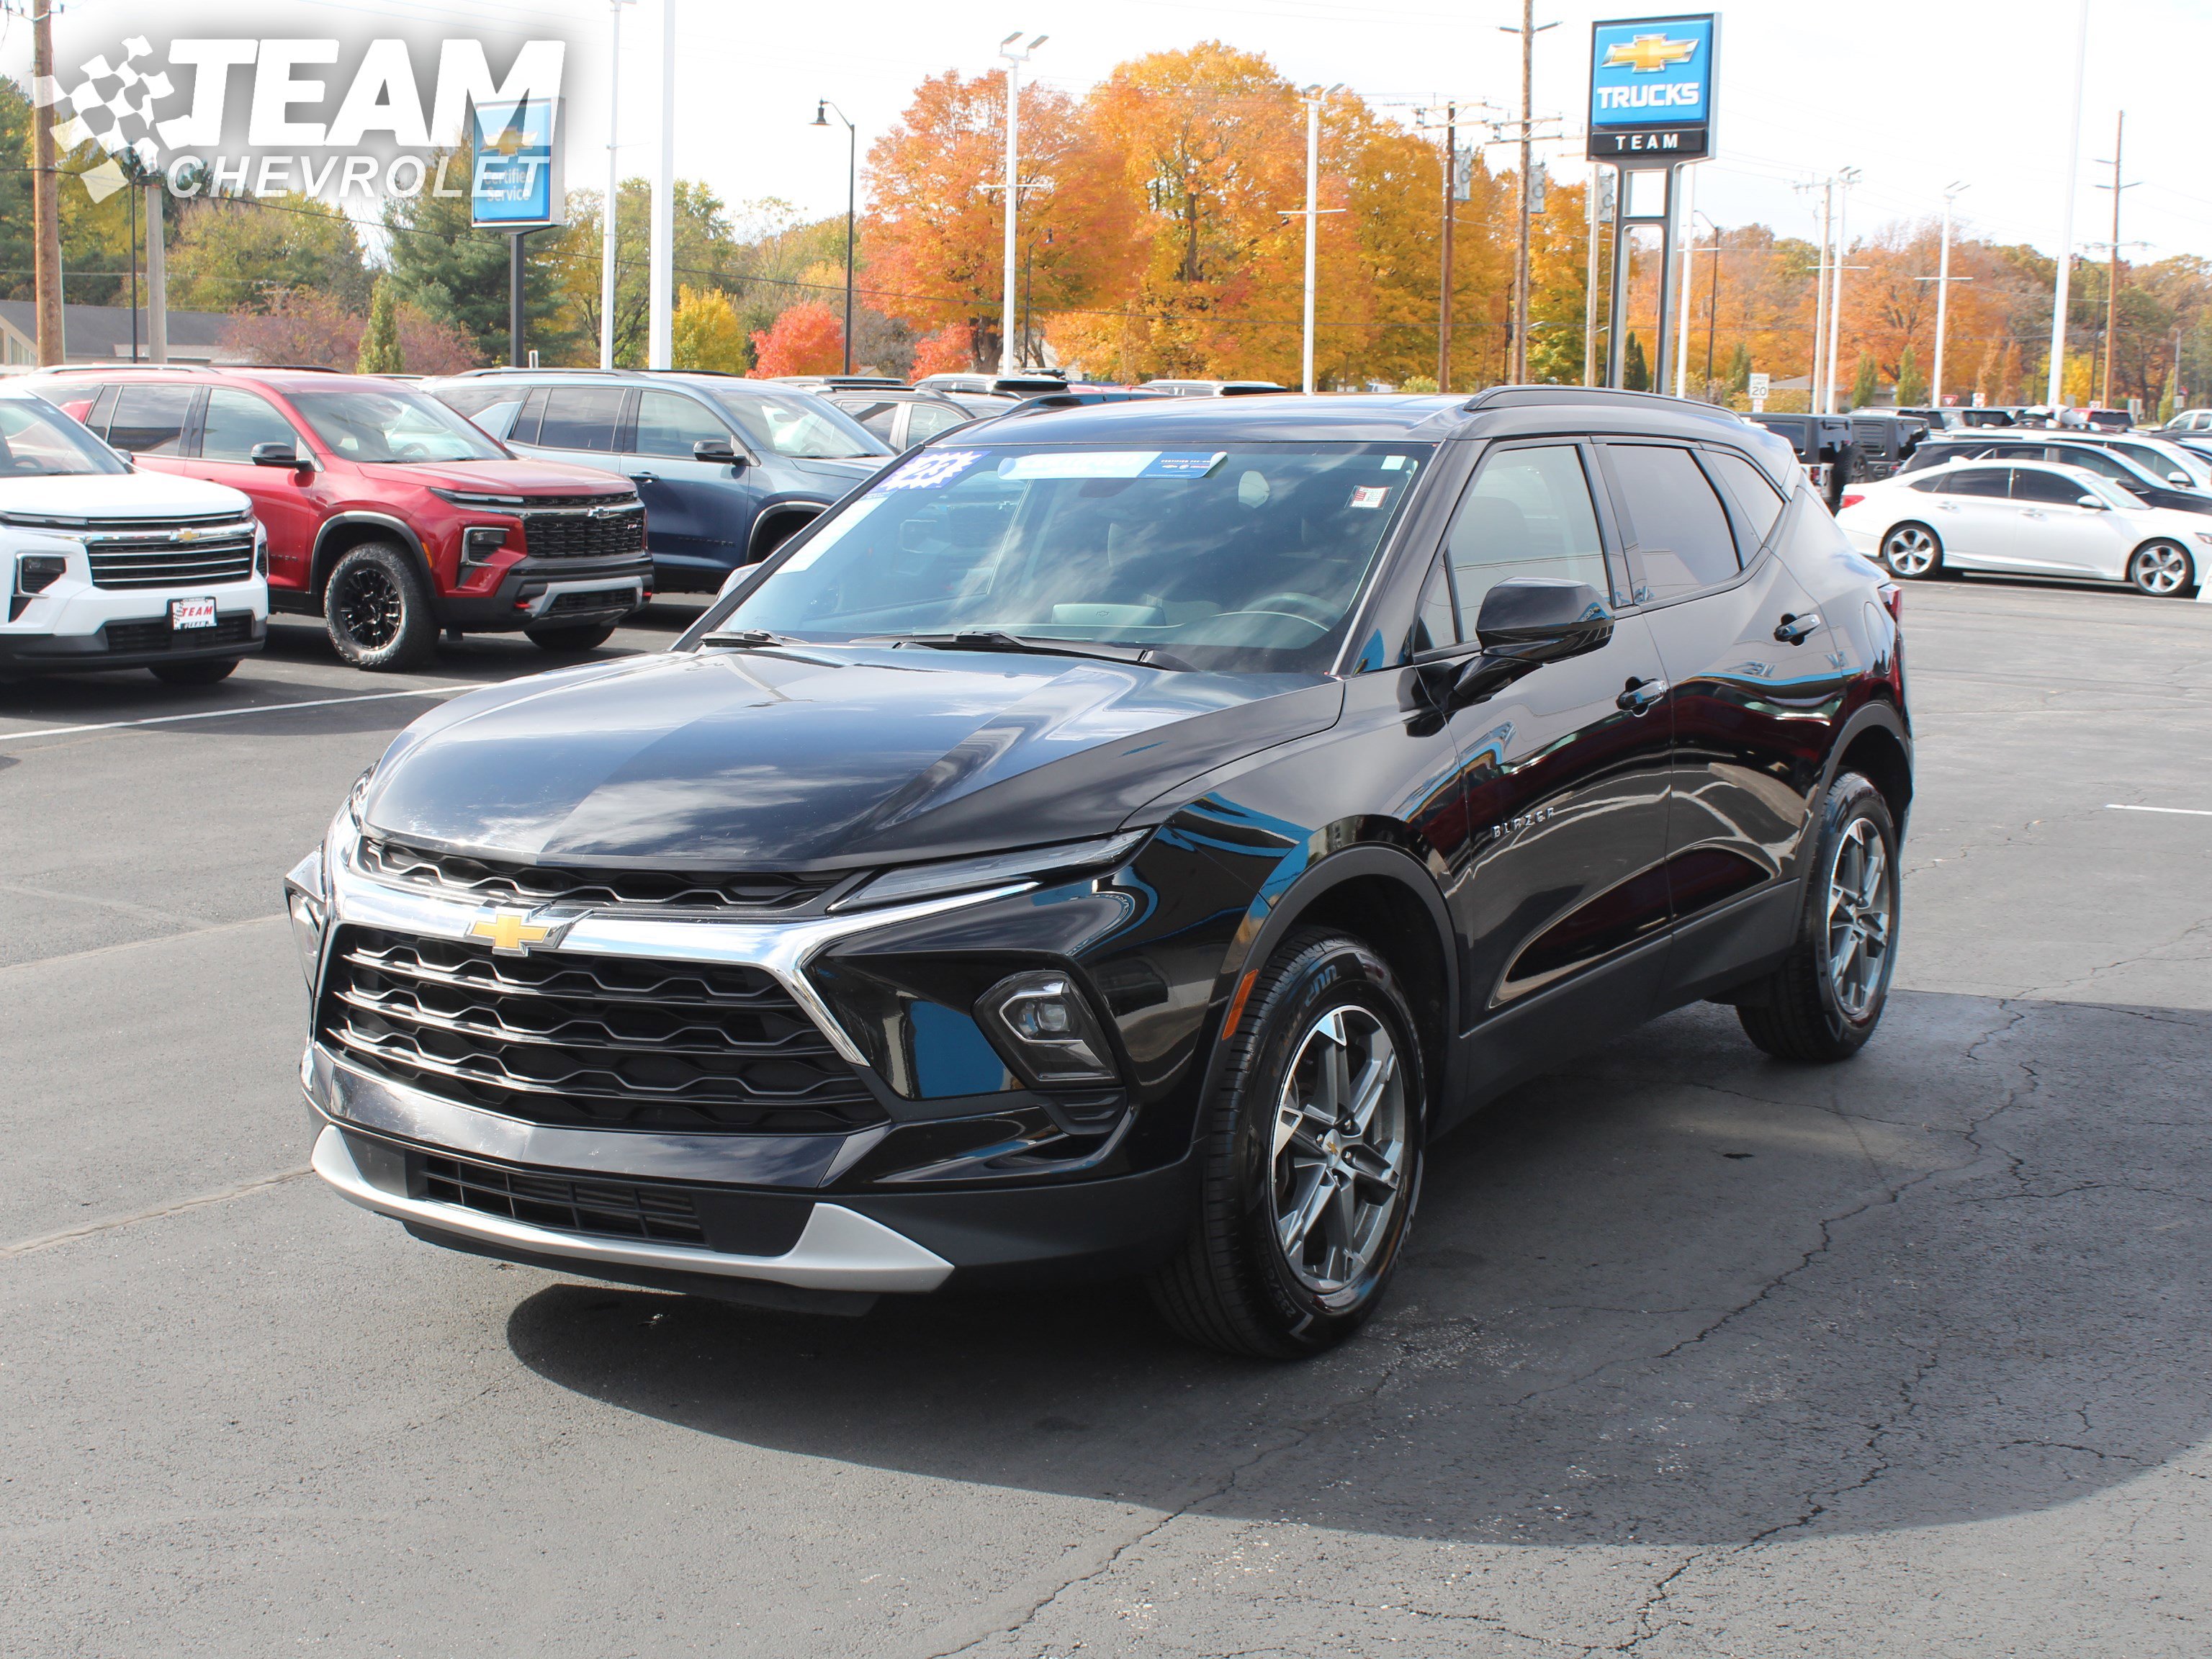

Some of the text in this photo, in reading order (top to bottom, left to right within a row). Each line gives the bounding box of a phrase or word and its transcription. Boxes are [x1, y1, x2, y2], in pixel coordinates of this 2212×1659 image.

[1596, 82, 1699, 109] TRUCKS
[1615, 134, 1678, 150] TEAM
[483, 168, 533, 184] Certified
[487, 185, 531, 202] Service
[1752, 386, 1767, 396] 20
[183, 606, 212, 617] TEAM
[1491, 807, 1555, 839] BLAZER
